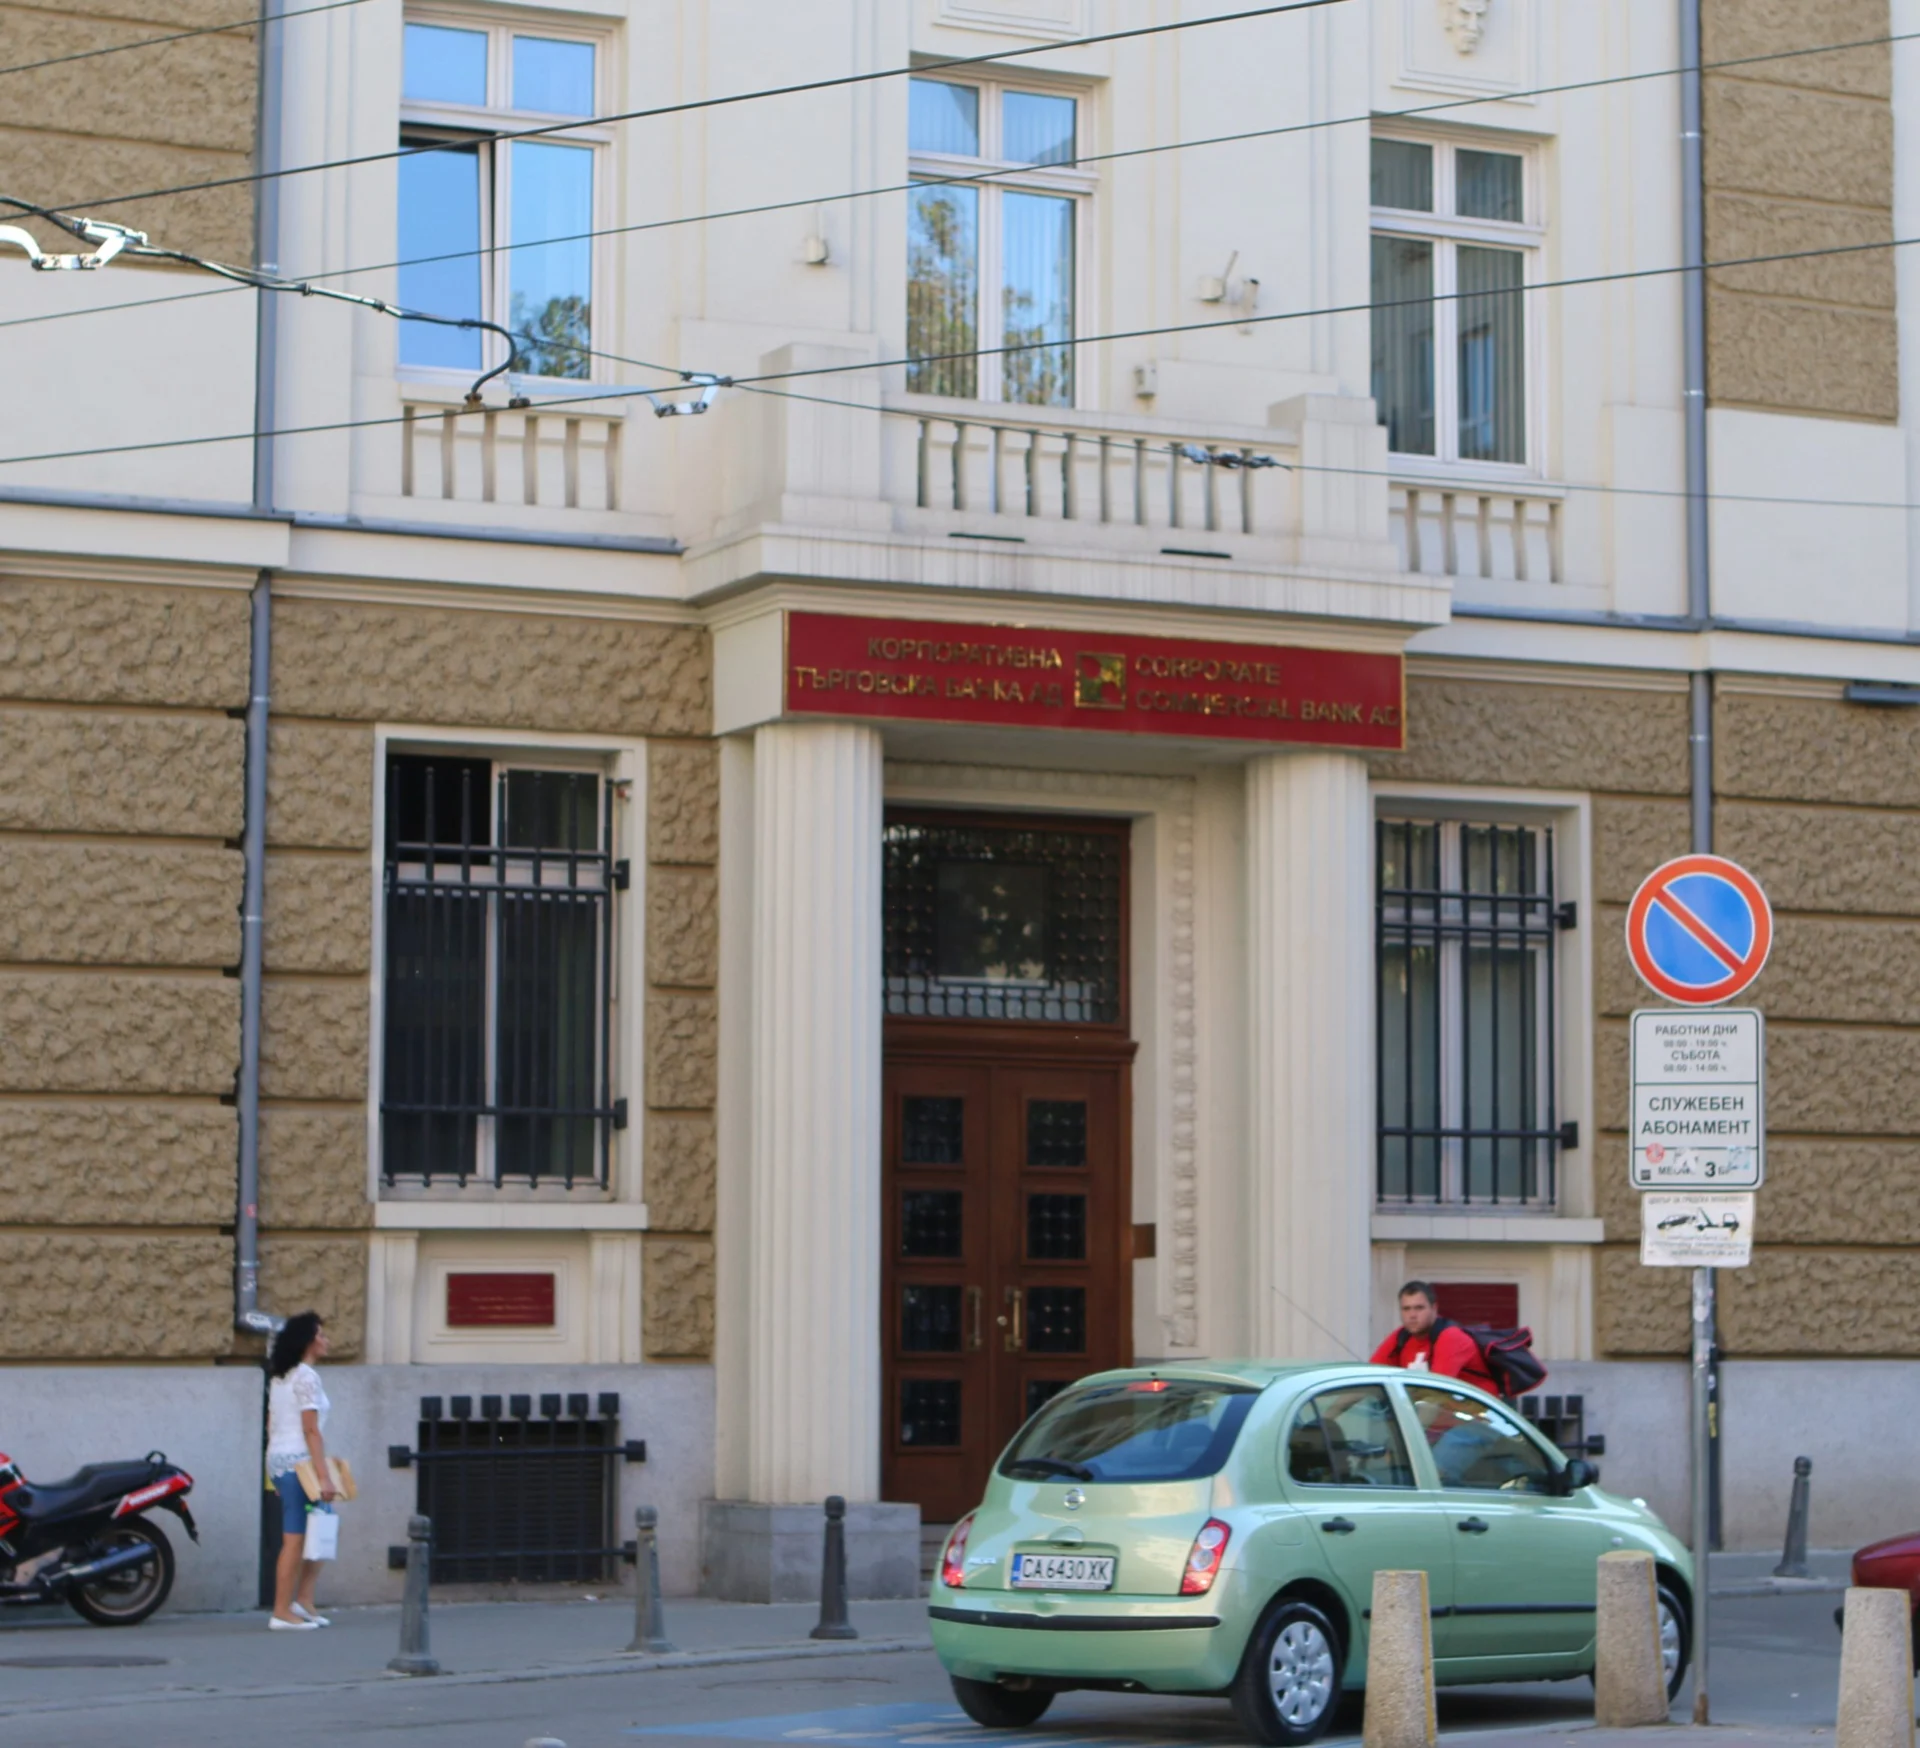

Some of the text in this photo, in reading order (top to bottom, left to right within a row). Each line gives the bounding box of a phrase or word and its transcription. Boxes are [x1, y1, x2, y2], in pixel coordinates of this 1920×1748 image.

[868, 637, 1063, 669] КОРПОРАТИВНА
[1135, 655, 1281, 685] CORPORATE
[795, 666, 938, 696] ТЪРГОВСКА
[945, 677, 1024, 703] БАНКА
[1136, 688, 1400, 726] COMMERCIAL BANK AD
[1655, 1024, 1738, 1036] РАБОТНИ ДНИ
[1671, 1050, 1720, 1060] СЪБОТА
[1649, 1097, 1744, 1111] СЛУЖЕБЕН
[1641, 1120, 1750, 1134] АБОНАМЕНТ
[1705, 1161, 1716, 1178] 3
[1022, 1558, 1045, 1579] CA
[1047, 1560, 1085, 1580] 6430
[1088, 1560, 1110, 1581] XK
